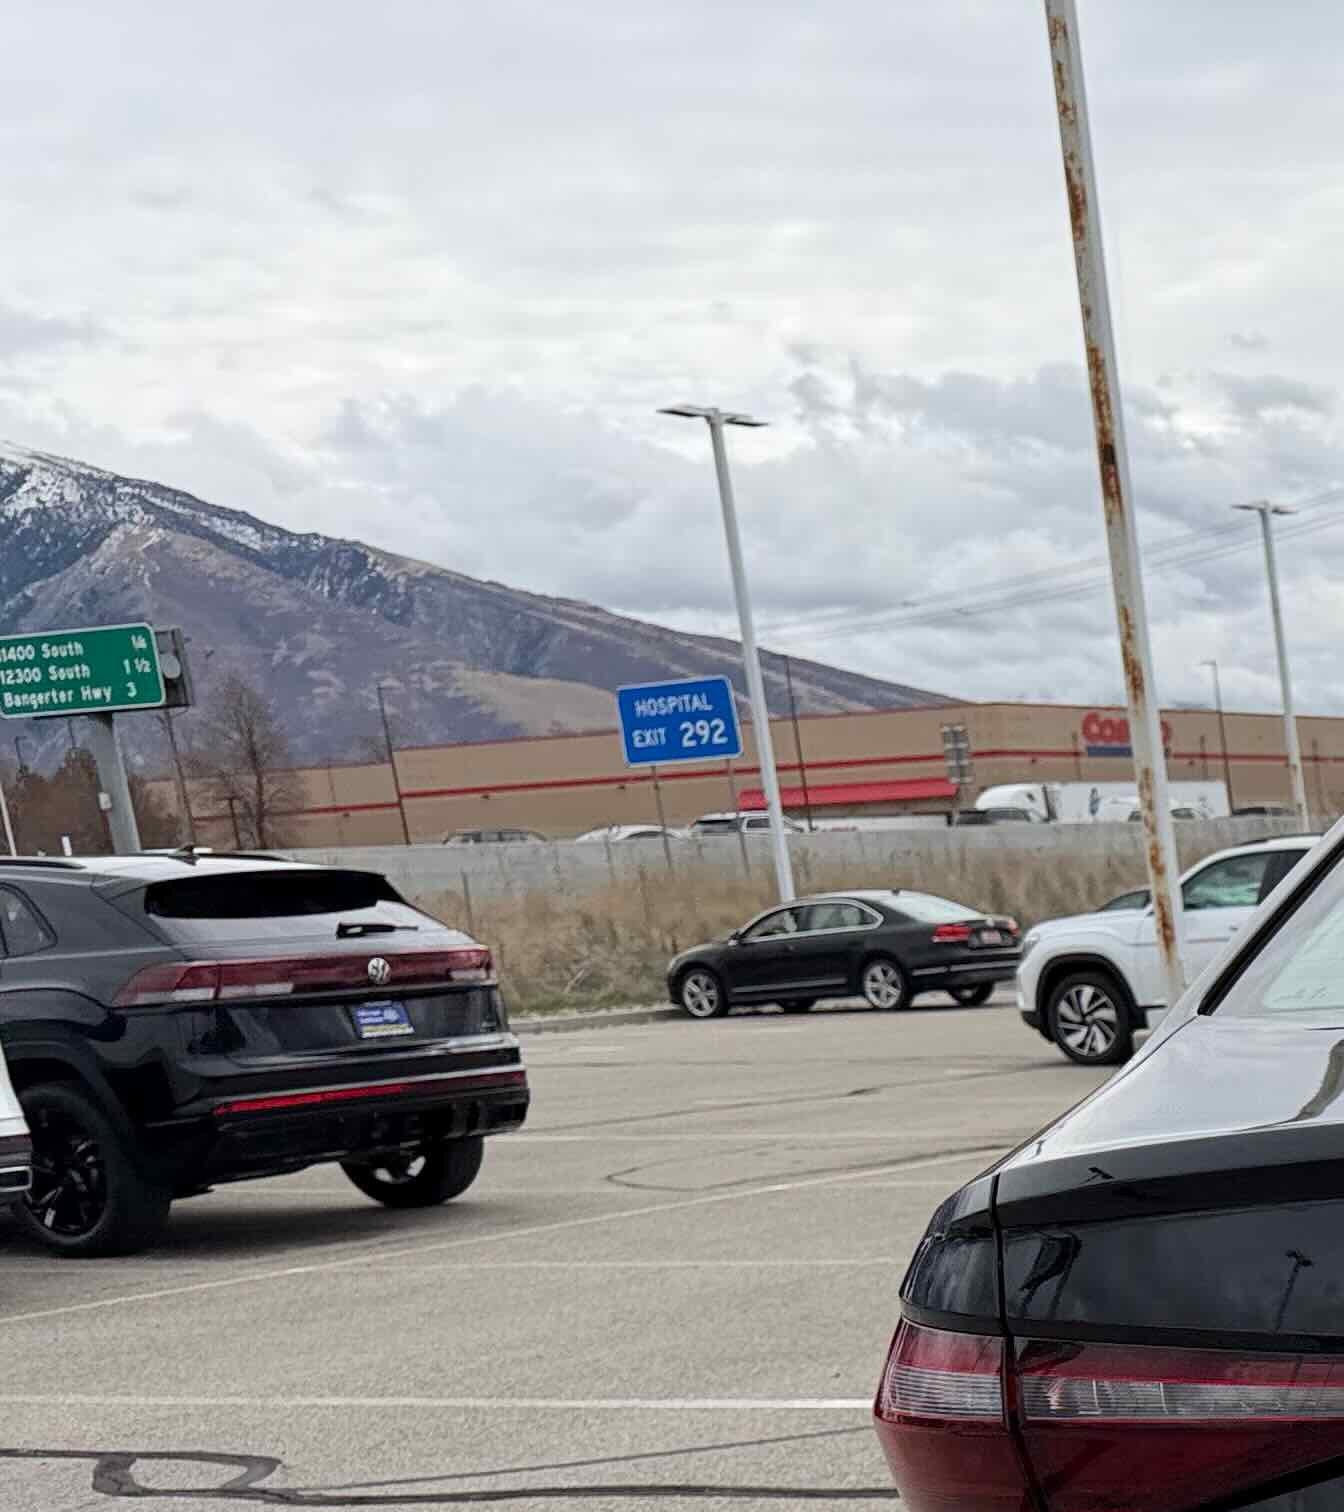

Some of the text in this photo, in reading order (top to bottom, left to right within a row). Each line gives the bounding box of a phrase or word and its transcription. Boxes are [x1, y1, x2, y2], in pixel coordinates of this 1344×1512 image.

[0, 641, 84, 663] 1400 South
[0, 664, 91, 685] 12300 South
[3, 685, 113, 710] Bangerter Hwy
[126, 681, 138, 698] 3
[633, 692, 714, 718] HOSPITAL
[632, 718, 729, 749] EXIT 292
